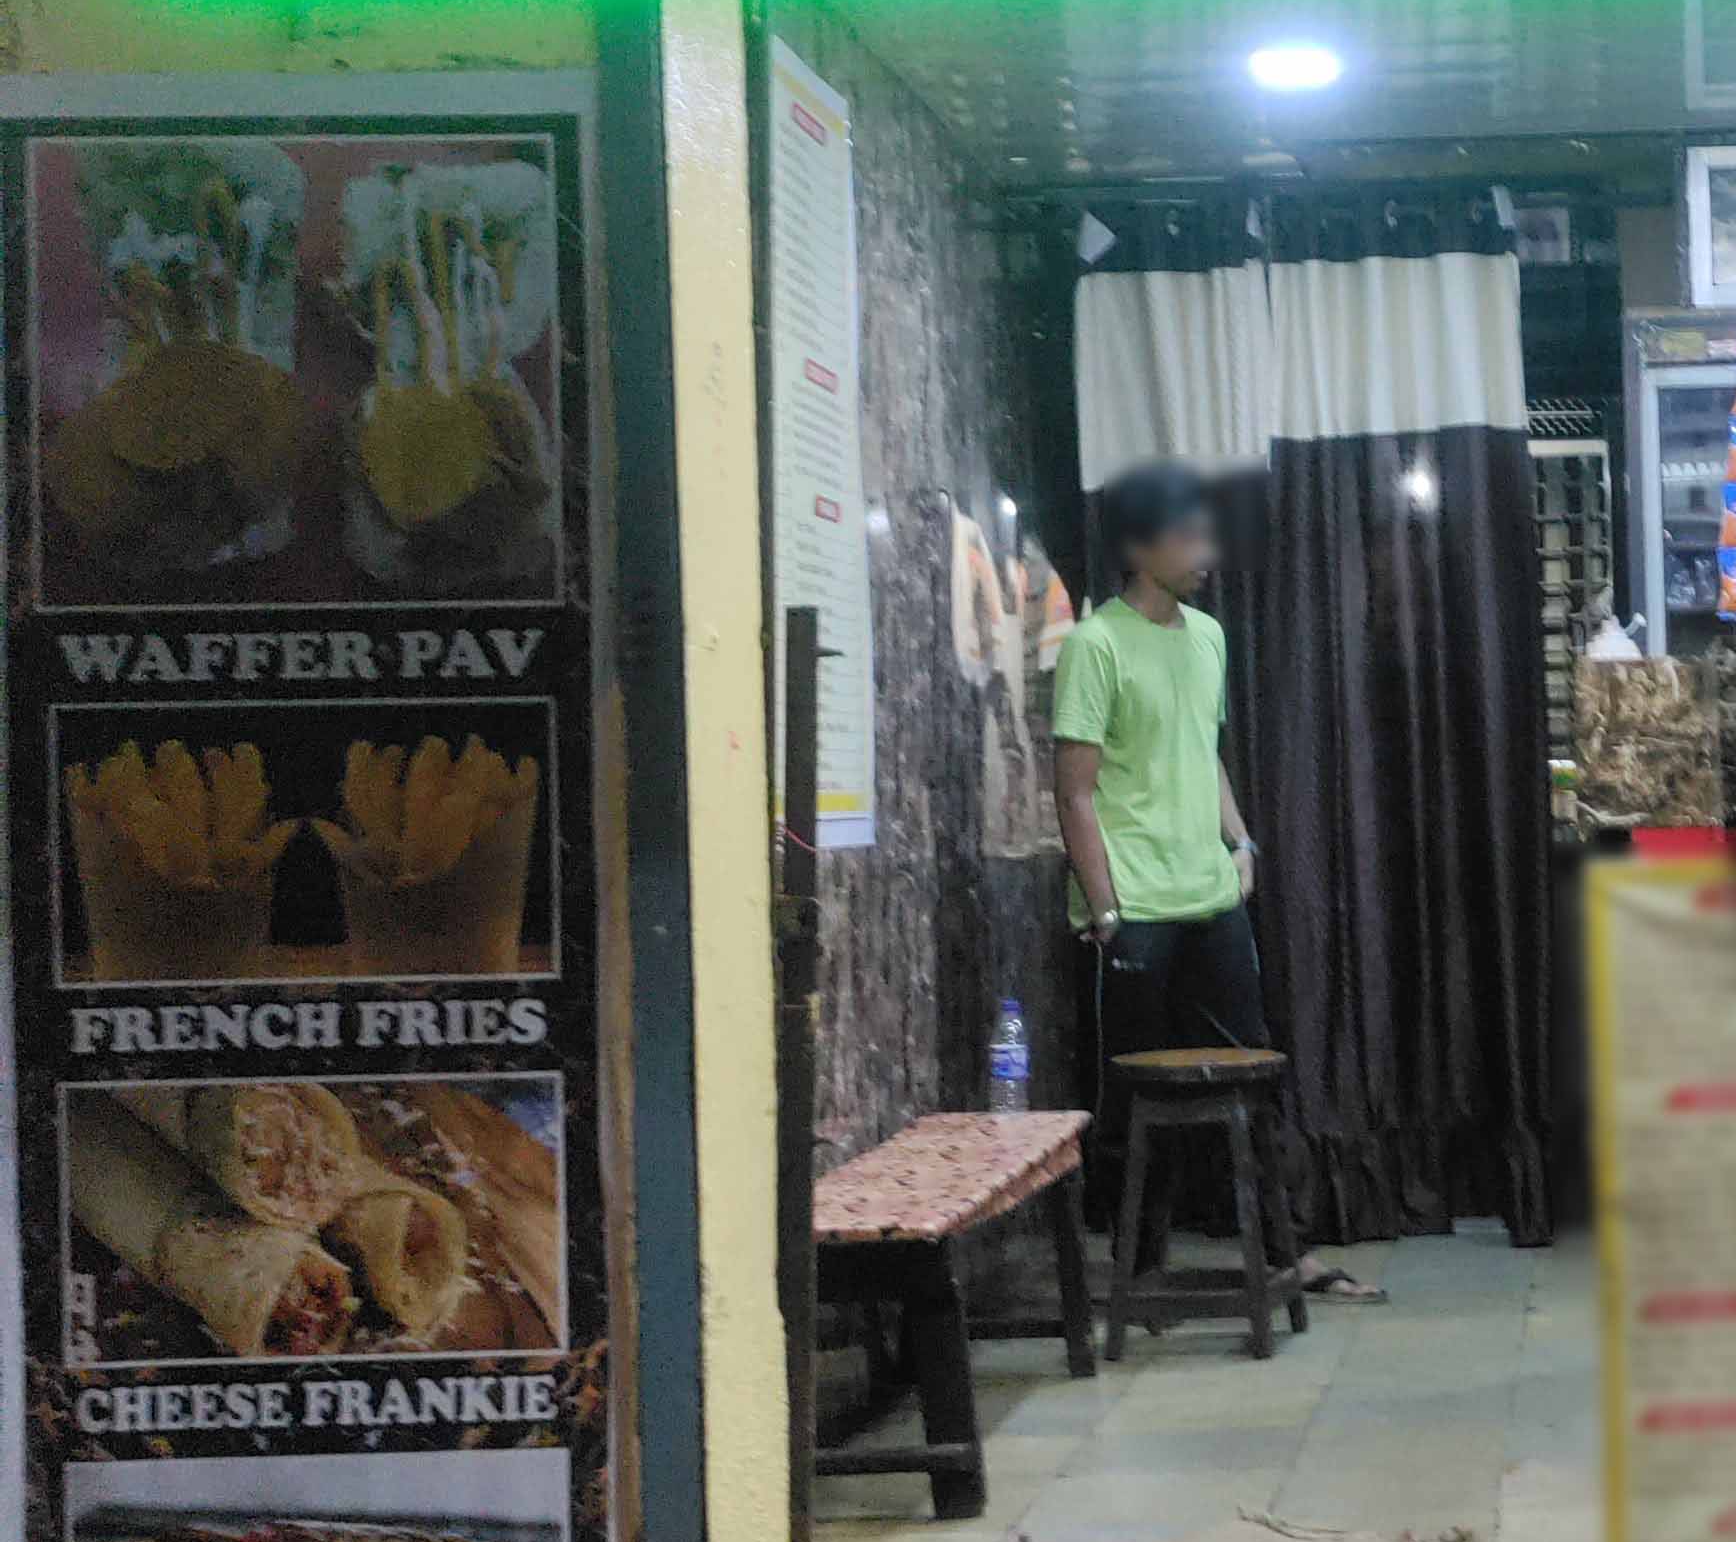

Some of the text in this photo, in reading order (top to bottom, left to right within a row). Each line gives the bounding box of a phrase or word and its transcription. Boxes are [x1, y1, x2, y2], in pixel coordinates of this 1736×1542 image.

[57, 628, 545, 683] WAFFER PAV
[71, 998, 549, 1053] FRENCH FRIES
[77, 1375, 560, 1433] CHEESE FRANKIE
